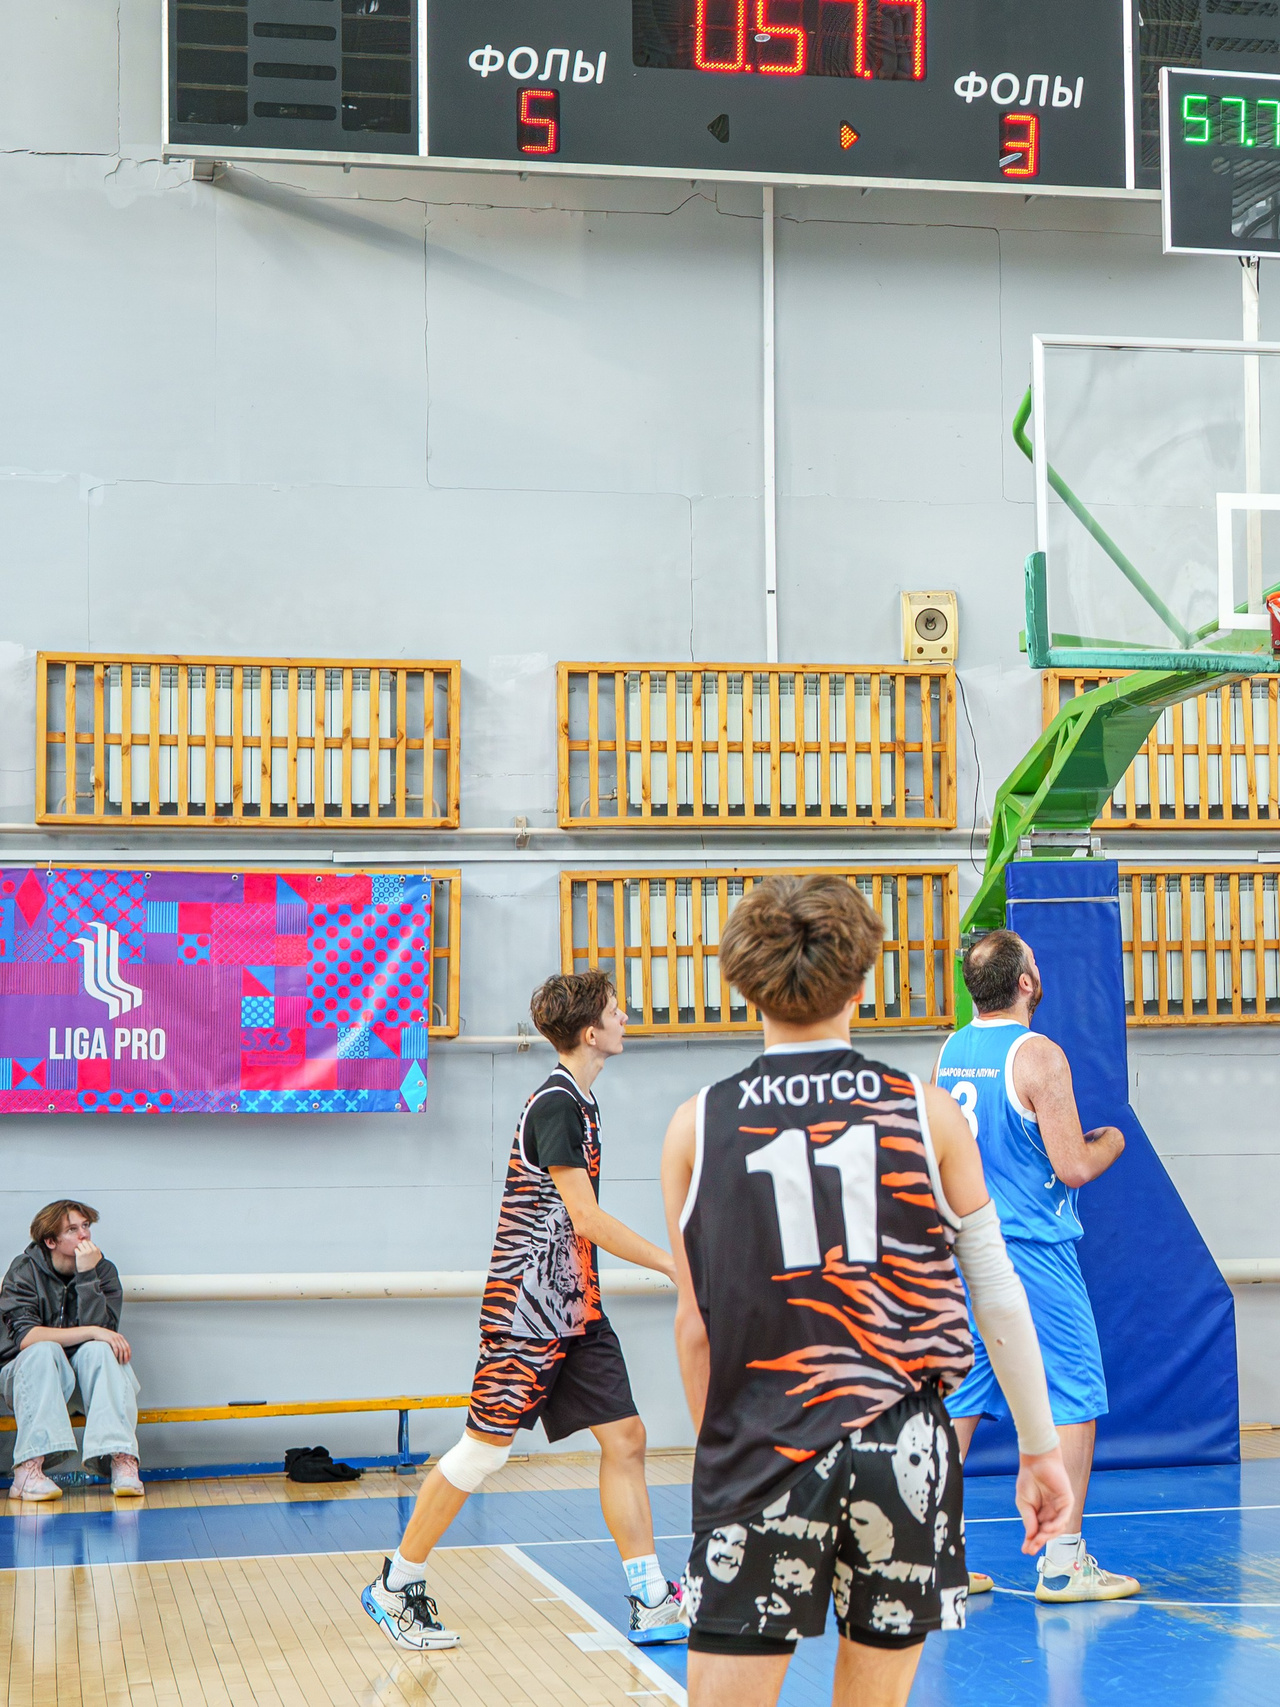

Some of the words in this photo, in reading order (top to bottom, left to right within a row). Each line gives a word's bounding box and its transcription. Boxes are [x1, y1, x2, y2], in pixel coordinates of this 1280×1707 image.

[468, 44, 607, 84] ФОЛЫ
[953, 71, 1084, 109] ФОЛЫ
[520, 89, 556, 152] 5
[1183, 95, 1280, 147] 57.7
[1003, 113, 1038, 176] 3
[49, 1027, 110, 1061] LIGA
[115, 1027, 167, 1061] PRO
[738, 1069, 882, 1109] ХКОТСО
[745, 1123, 878, 1270] 11
